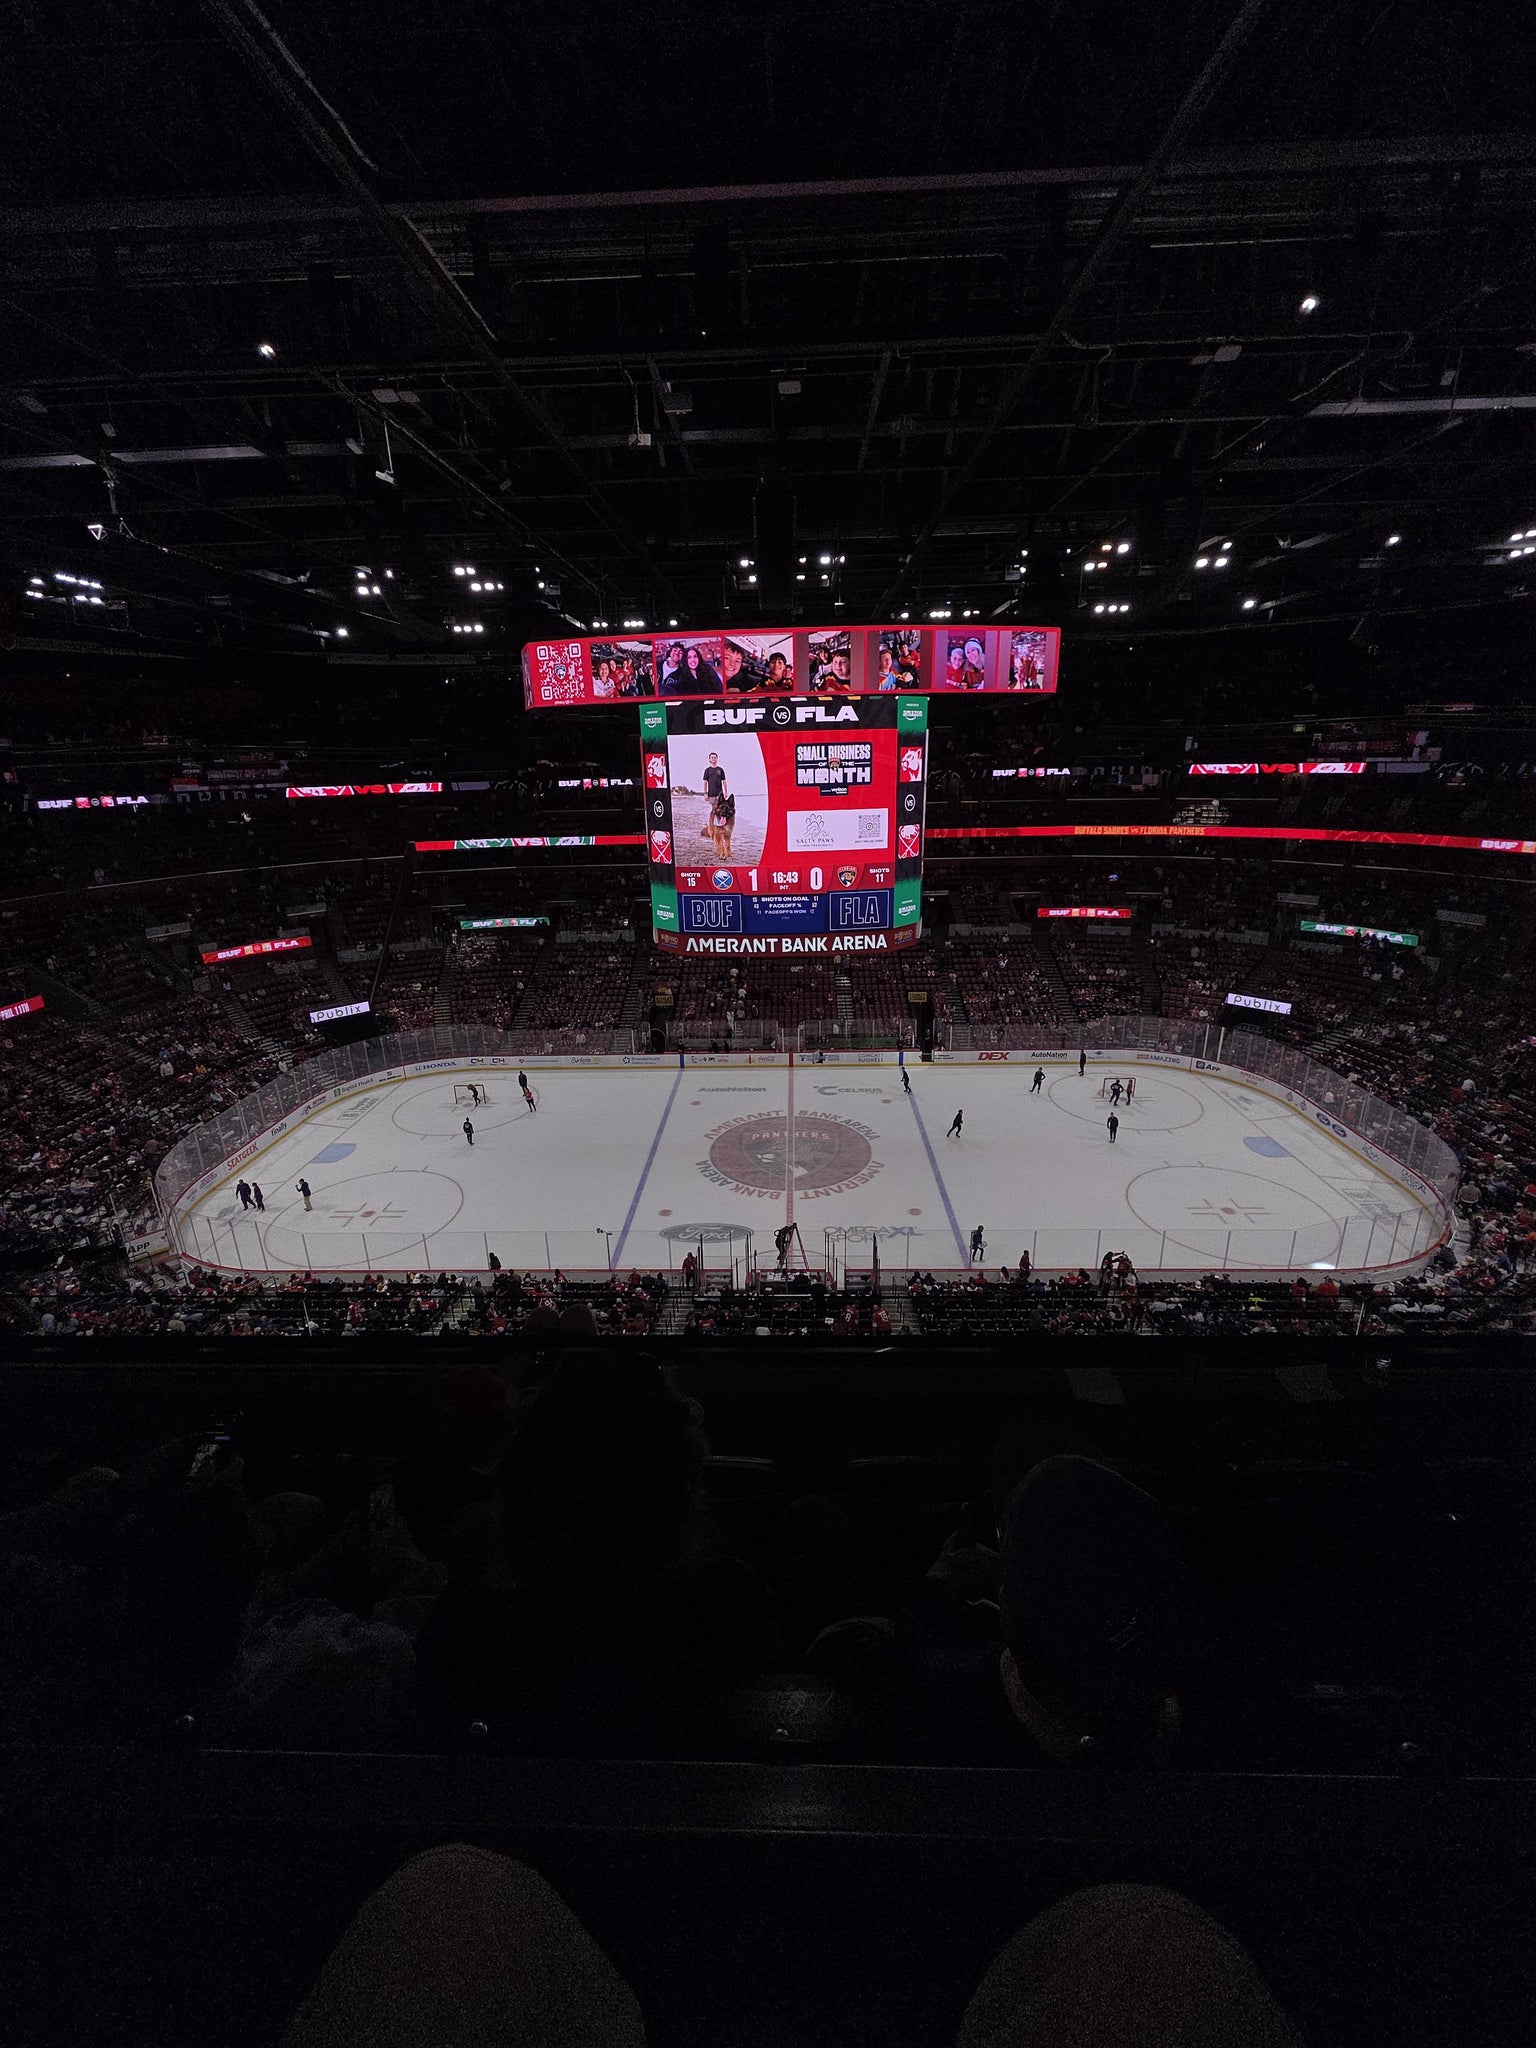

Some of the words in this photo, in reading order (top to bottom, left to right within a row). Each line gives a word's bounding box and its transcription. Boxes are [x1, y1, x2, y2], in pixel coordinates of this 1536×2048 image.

[704, 708, 765, 726] BUF
[776, 711, 788, 720] VS
[796, 706, 859, 723] FLA
[797, 745, 827, 761] SMALL
[828, 744, 871, 760] BUSINESS
[993, 769, 1016, 777] BUF
[1046, 768, 1070, 776] FLA
[1260, 763, 1297, 773] VS
[355, 785, 388, 794] VS
[38, 800, 73, 809] BUF
[116, 796, 149, 804] FLA
[1075, 826, 1102, 835] BUFFALO
[1140, 826, 1167, 835] FLORIDA
[1169, 826, 1205, 836] PANTHERS
[514, 837, 545, 847] VS
[1481, 840, 1518, 850] BUF
[687, 878, 696, 887] 15
[748, 868, 758, 891] 1
[772, 871, 799, 884] 16:43
[810, 867, 823, 890] 0
[875, 873, 884, 882] 11
[691, 899, 732, 927] BUF
[839, 895, 880, 924] FLA
[1097, 909, 1119, 917] FLA
[217, 949, 242, 960] BUF
[273, 939, 300, 950] FLA
[686, 937, 778, 953] AMERANT
[781, 936, 828, 952] BANK
[831, 934, 888, 950] ARENA
[1233, 995, 1280, 1012] Publix
[316, 1005, 361, 1021] Publix
[978, 1052, 1011, 1061] DEX
[423, 1061, 457, 1070] HONDA
[704, 1109, 784, 1140] AMERANT
[798, 1109, 843, 1122] BANK
[839, 1119, 881, 1141] ARENA
[226, 1142, 260, 1171] SEATGEEK
[695, 1159, 735, 1187] ARENA
[798, 1160, 886, 1200] AMERANT
[729, 1183, 782, 1200] BANK
[678, 1225, 732, 1240] Ford
[128, 1242, 151, 1253] APP
